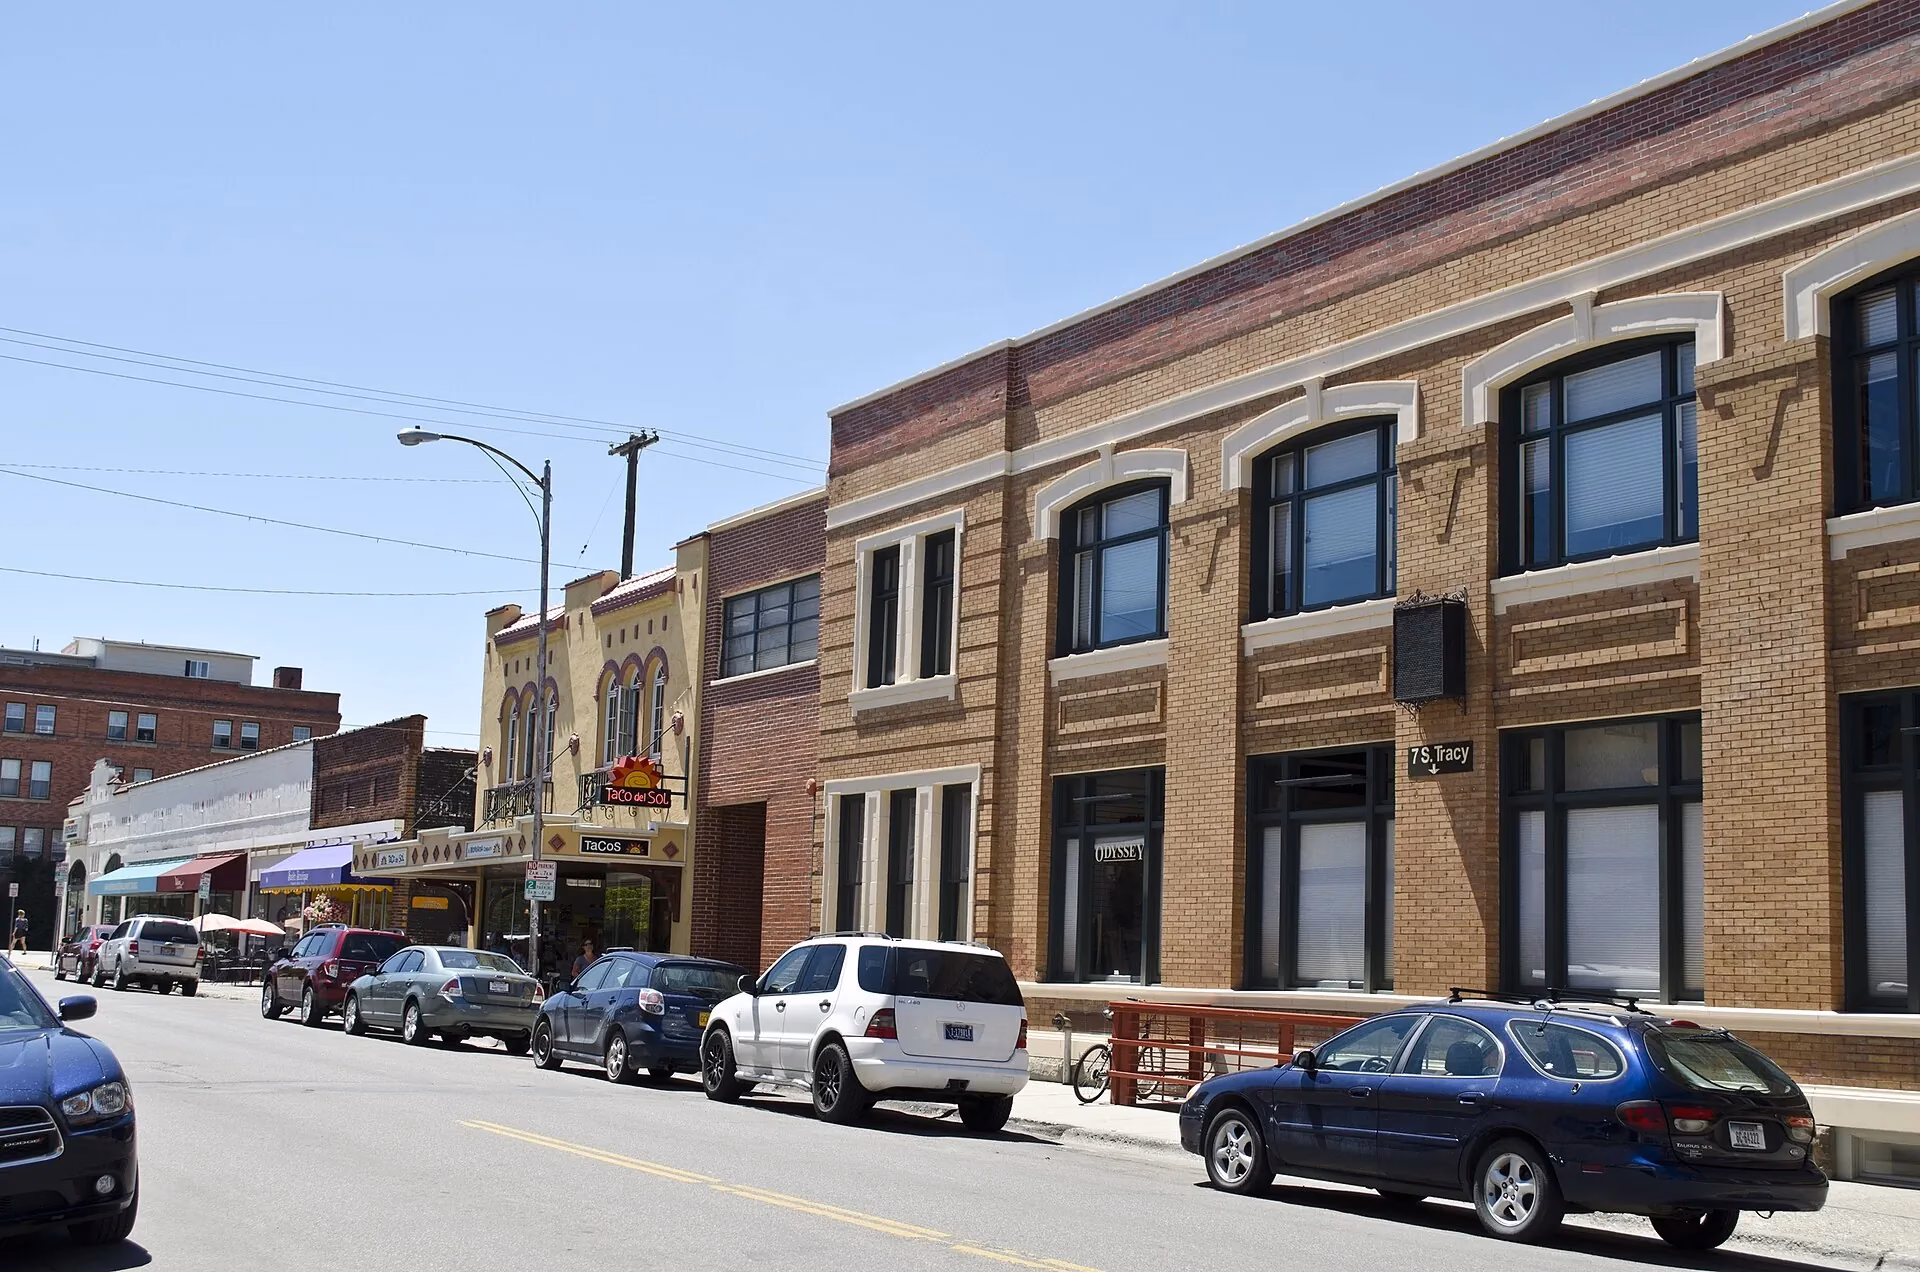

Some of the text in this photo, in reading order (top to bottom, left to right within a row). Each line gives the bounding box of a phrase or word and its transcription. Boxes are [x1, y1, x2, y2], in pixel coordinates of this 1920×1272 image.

[1411, 747, 1419, 765] 7
[1434, 745, 1470, 764] Tracy
[1095, 844, 1144, 862] ODYSSEY
[528, 861, 537, 870] NO
[528, 880, 534, 889] 2
